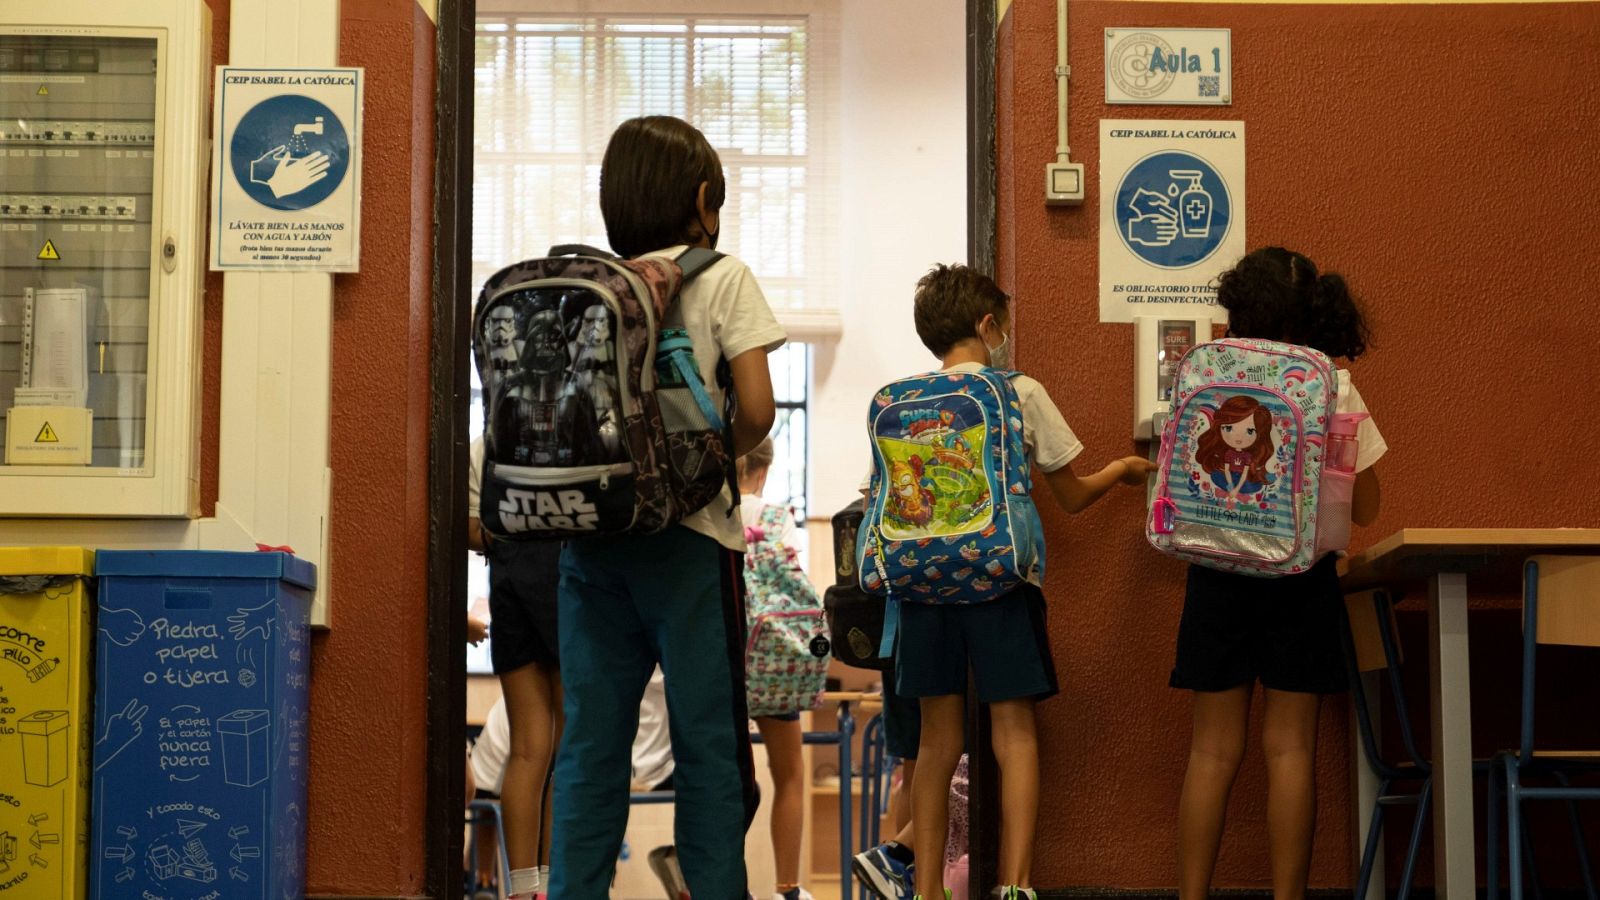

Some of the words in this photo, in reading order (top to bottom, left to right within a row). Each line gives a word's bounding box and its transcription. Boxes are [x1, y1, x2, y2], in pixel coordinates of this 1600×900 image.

[1148, 46, 1201, 73] Aula
[1212, 47, 1220, 73] 1
[226, 76, 250, 84] CEIP
[251, 76, 286, 84] ISABEL
[304, 75, 355, 85] CATÓLICA
[1110, 130, 1133, 138] CEIP
[1135, 130, 1169, 138] ISABEL
[1171, 130, 1184, 138] LA
[1186, 128, 1236, 139] CATÓLICA
[229, 221, 265, 230] LÁVATE
[301, 232, 332, 241] JABÓN
[1126, 285, 1189, 293] OBLIGATORIO
[1147, 296, 1218, 304] DESINFECTANT
[499, 488, 596, 515] STAR
[499, 511, 599, 534] WARS
[1196, 505, 1222, 521] LITTLE
[1239, 512, 1259, 526] LADY
[3, 648, 30, 665] pillo
[155, 643, 218, 664] papel
[144, 672, 157, 684] o
[163, 667, 229, 688] tijera
[160, 718, 171, 728] El
[177, 718, 210, 728] papel
[160, 741, 211, 752] nunca
[160, 756, 210, 770] fuera
[198, 805, 220, 820] esto
